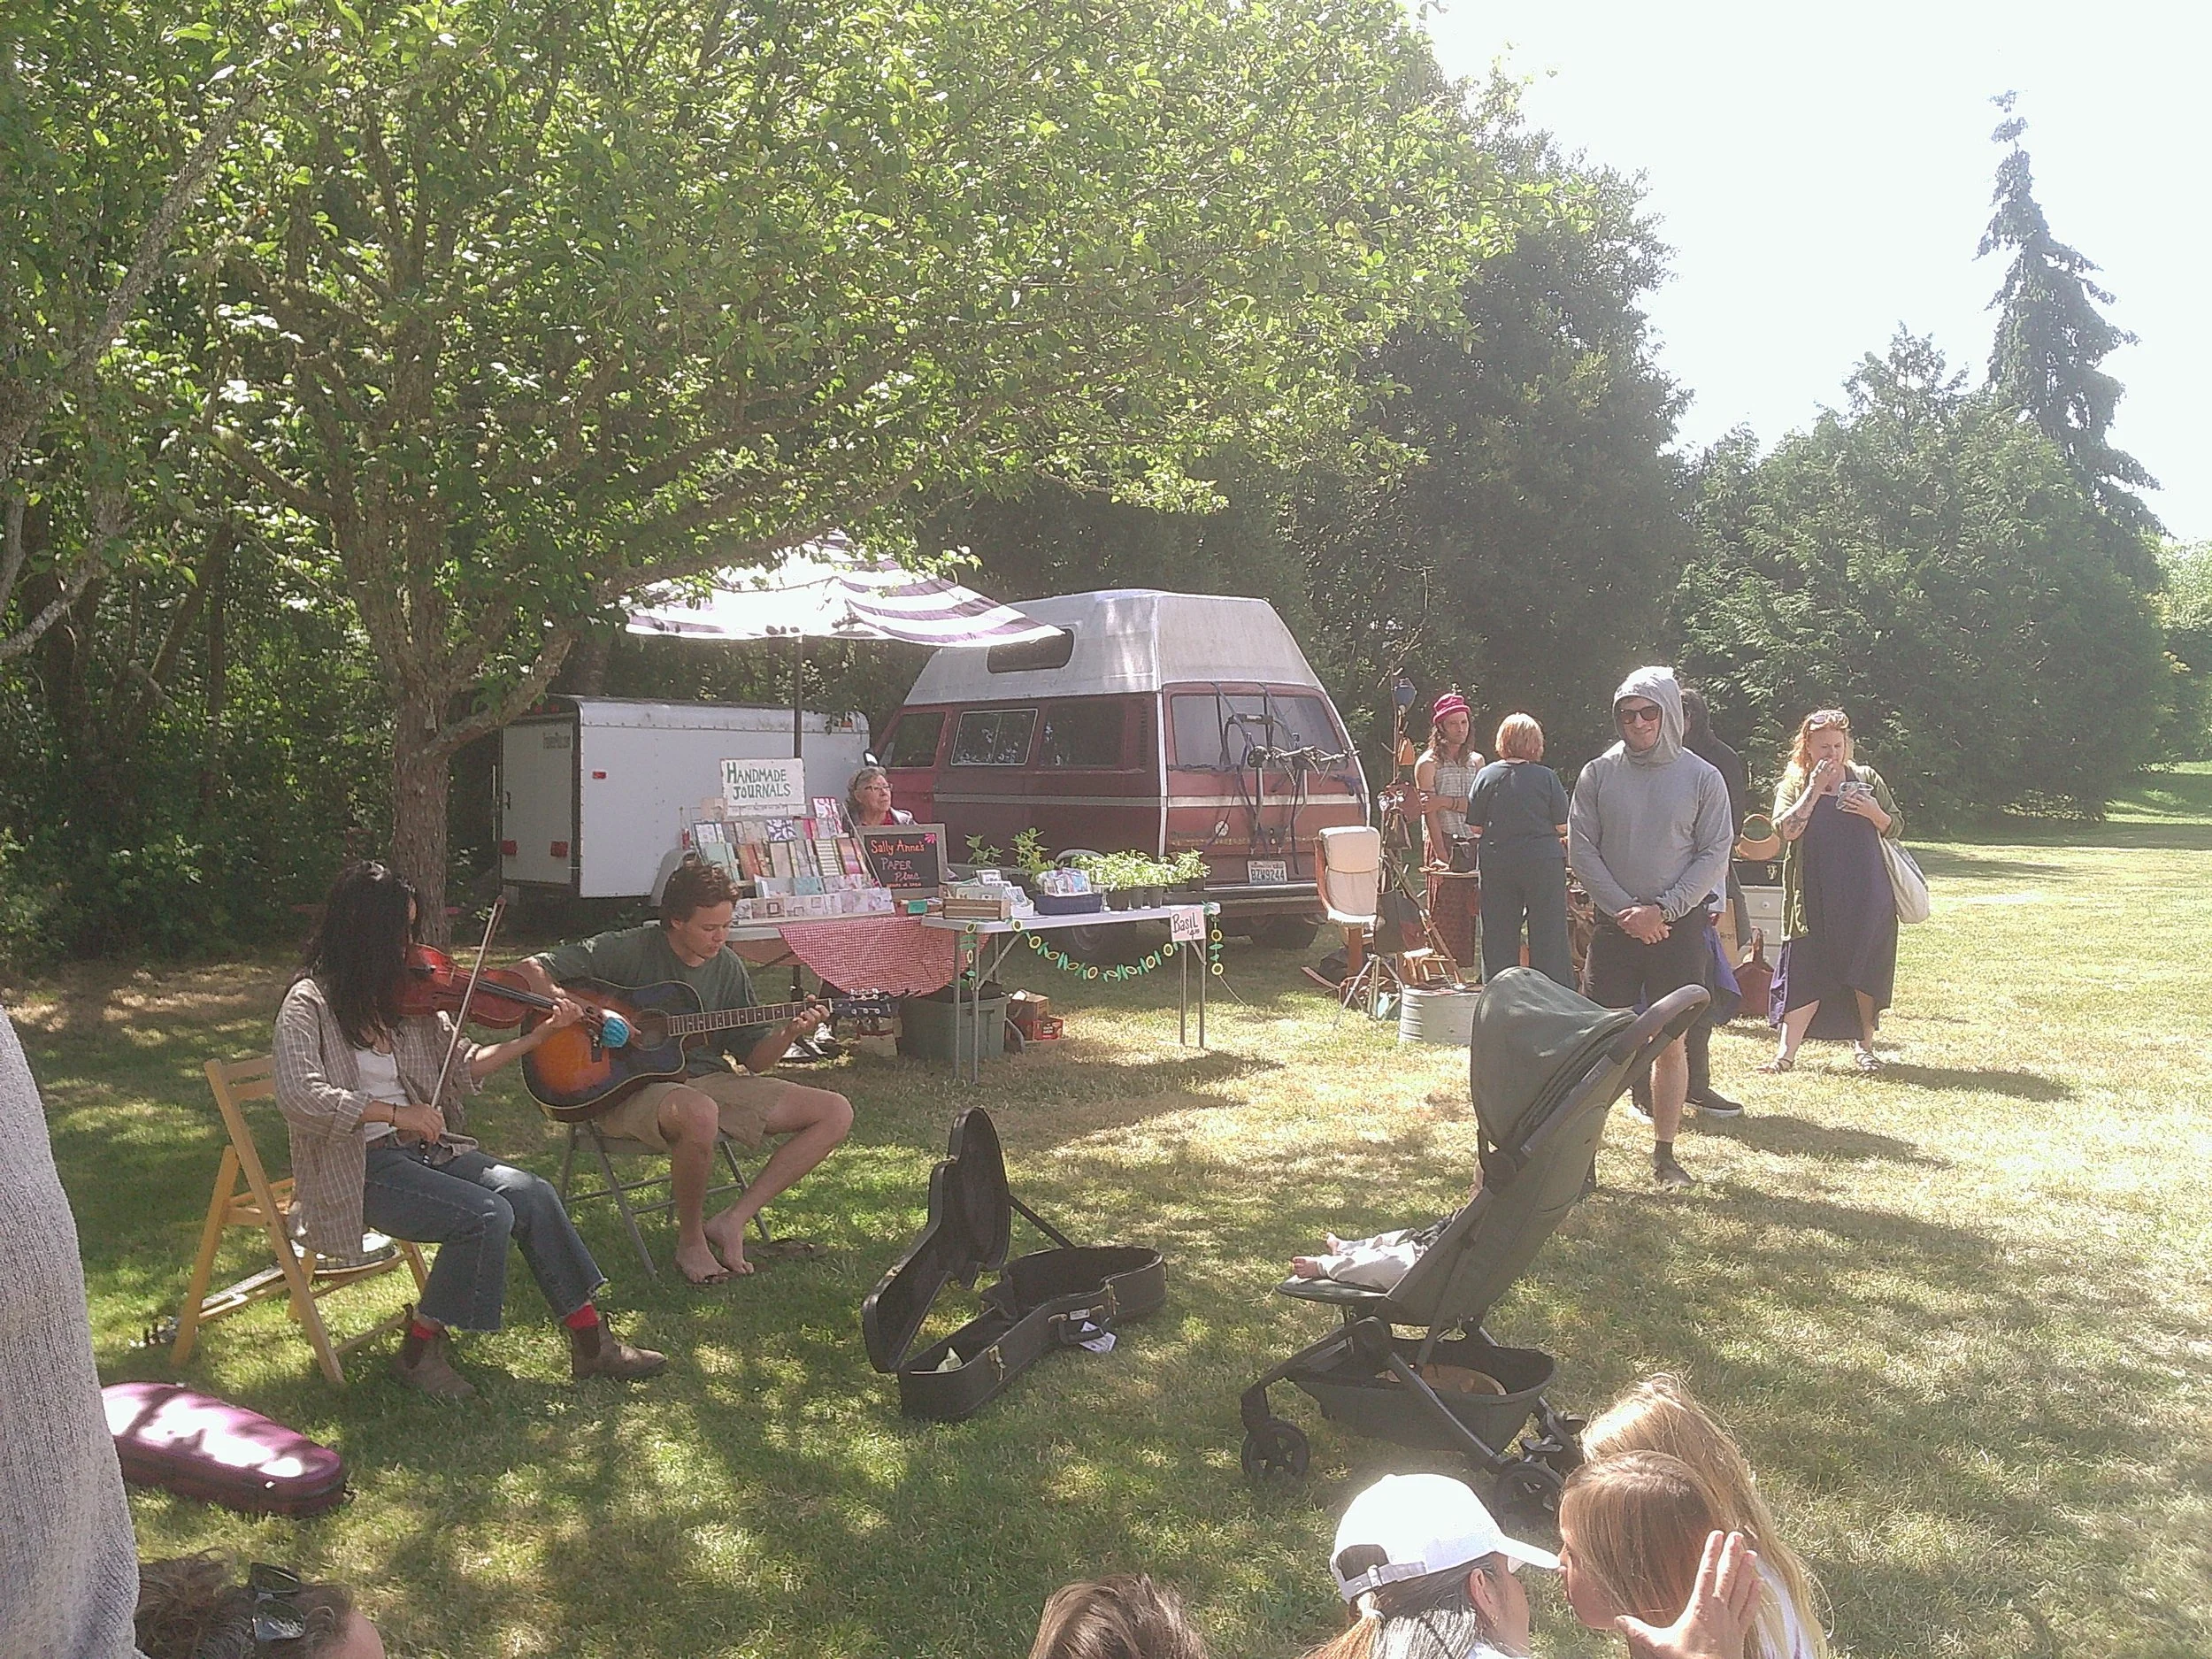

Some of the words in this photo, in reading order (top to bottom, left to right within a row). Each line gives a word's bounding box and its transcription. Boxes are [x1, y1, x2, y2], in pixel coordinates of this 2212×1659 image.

[726, 762, 787, 783] HANDMADE
[733, 783, 791, 800] JOURNALS
[871, 840, 894, 856] Sally
[897, 839, 925, 852] Anne's
[880, 856, 912, 870] PAPER
